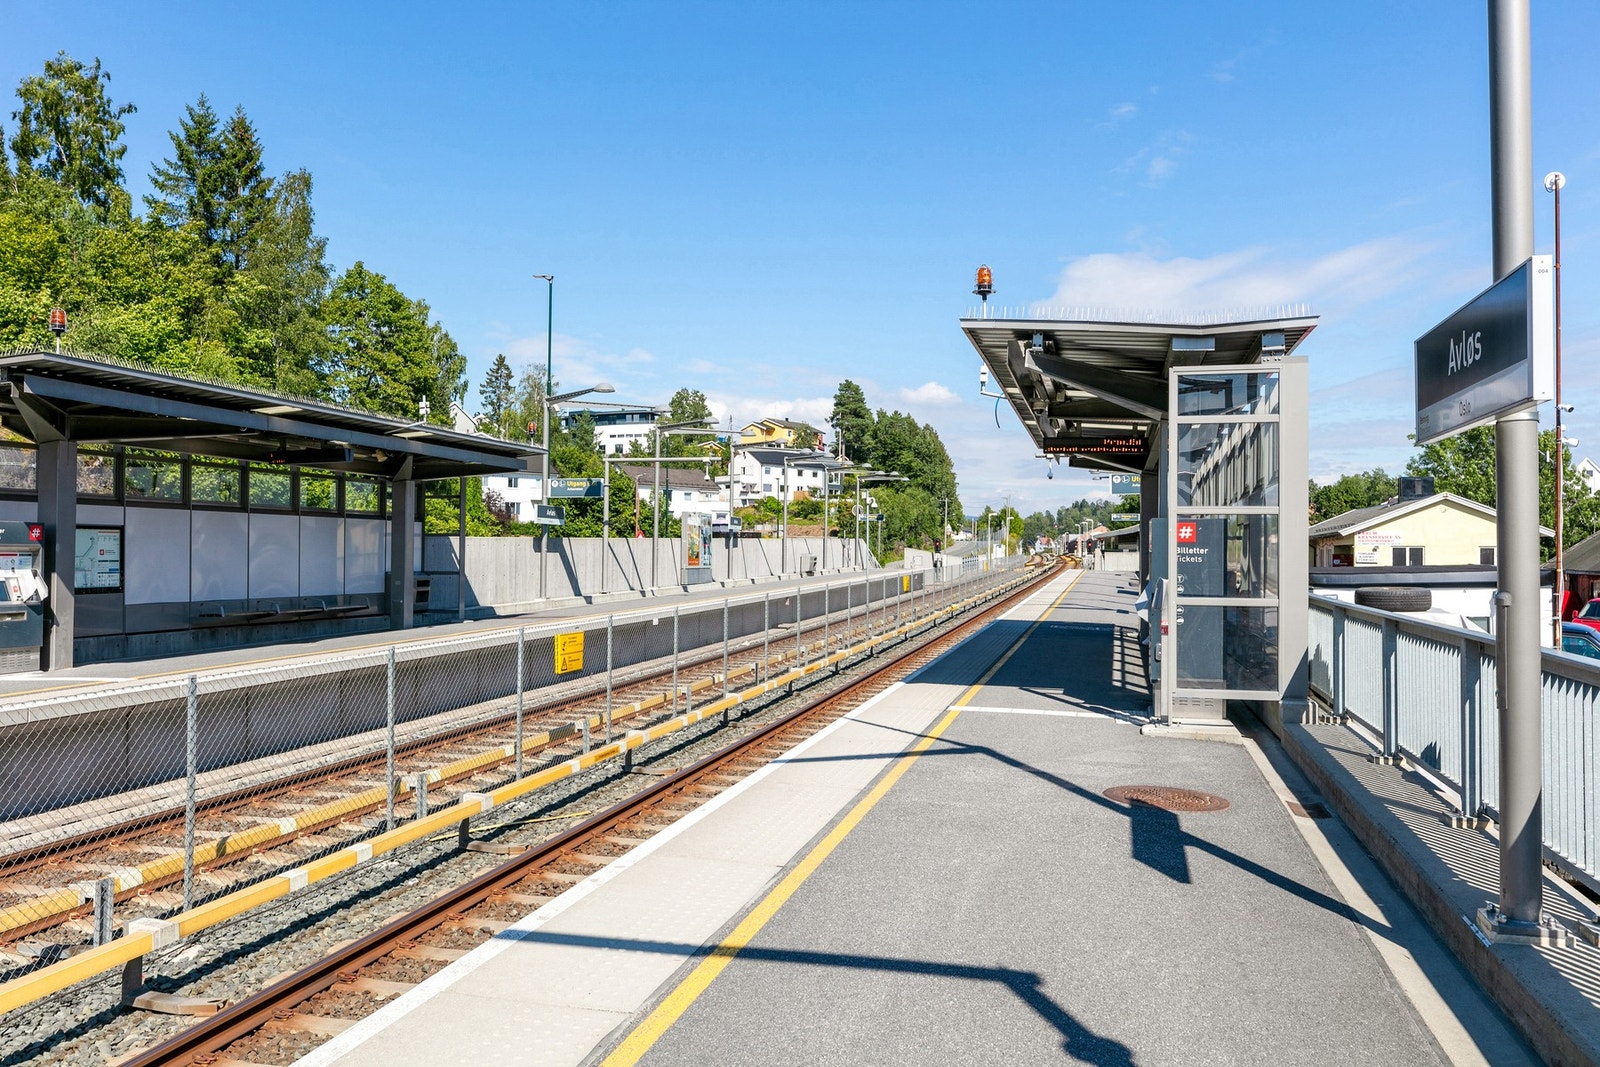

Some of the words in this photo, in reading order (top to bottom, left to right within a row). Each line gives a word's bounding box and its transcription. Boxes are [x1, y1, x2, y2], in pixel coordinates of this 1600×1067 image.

[1448, 330, 1482, 376] Avløs
[1458, 399, 1472, 417] Oslo
[1177, 546, 1209, 555] Billetter
